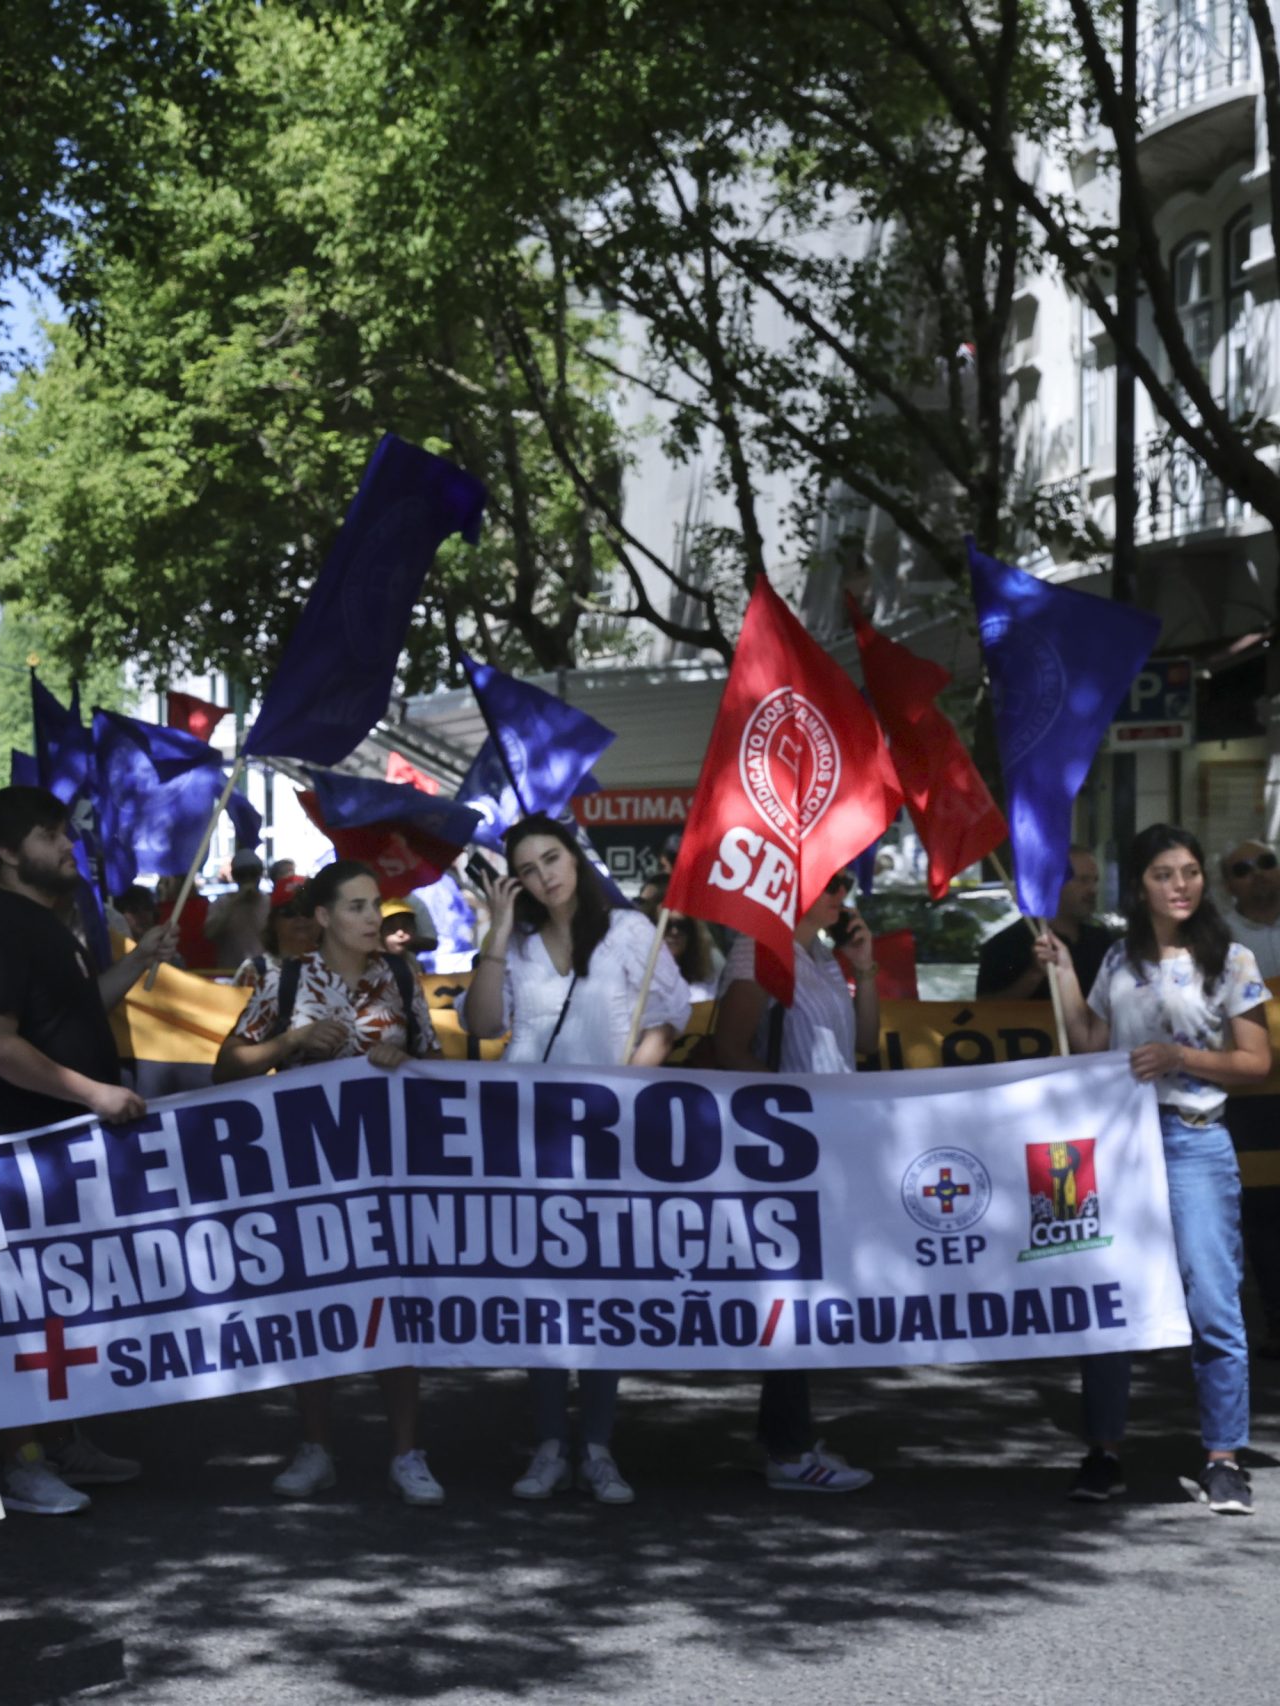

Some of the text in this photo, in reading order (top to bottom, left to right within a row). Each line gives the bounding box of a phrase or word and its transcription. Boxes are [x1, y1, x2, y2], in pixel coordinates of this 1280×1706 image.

[1131, 672, 1162, 713] P
[757, 699, 785, 732] DOS
[748, 734, 787, 828] SINDICATO
[583, 793, 695, 821] ÚLTIMA
[799, 785, 828, 830] POR
[1032, 1217, 1099, 1246] CGTP
[915, 1235, 987, 1266] SEP
